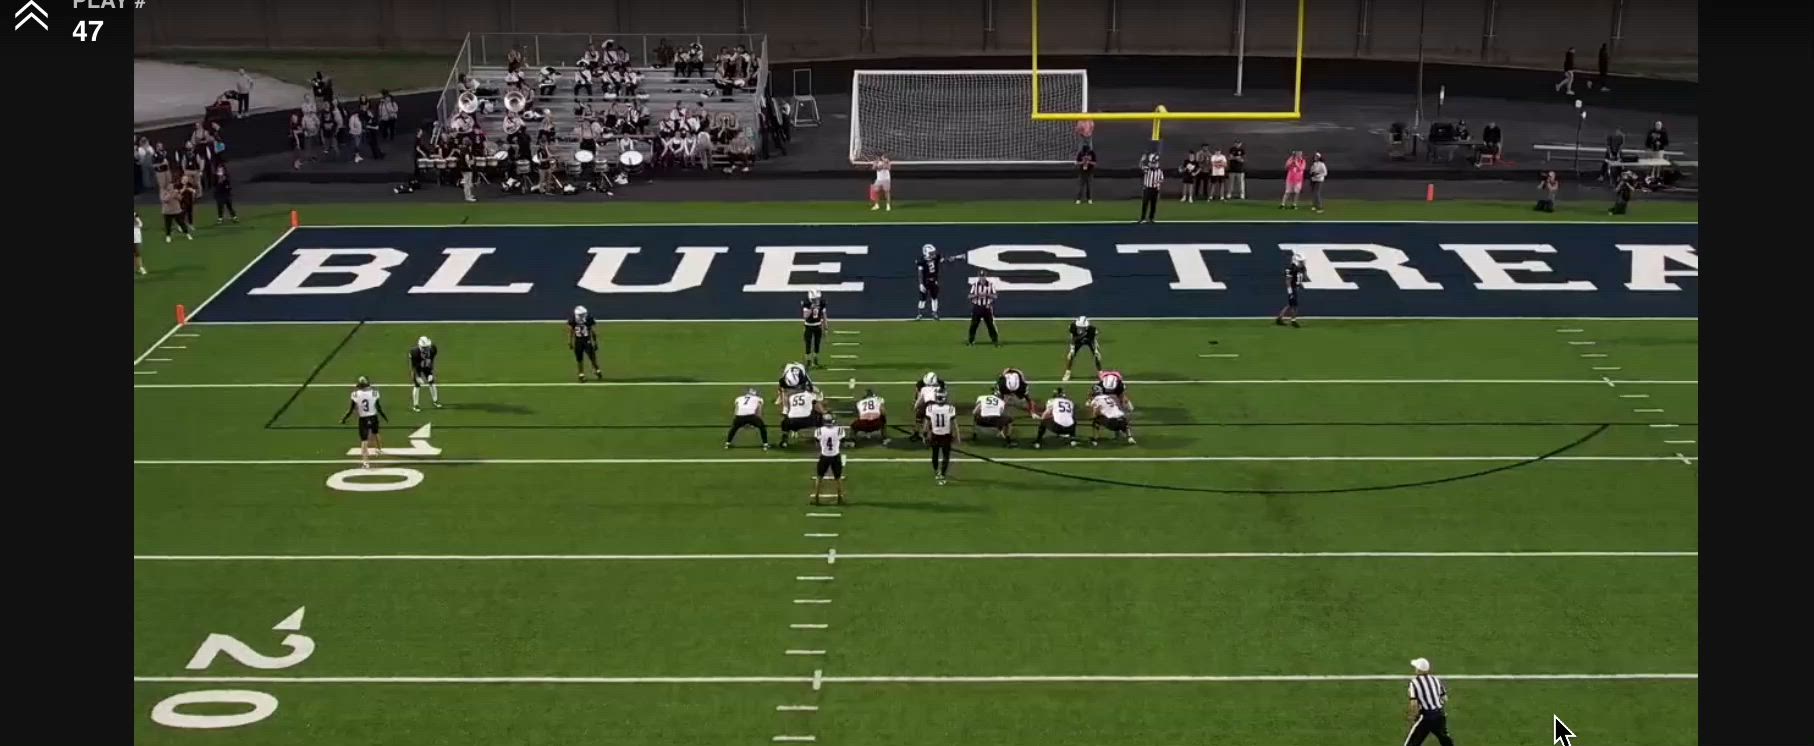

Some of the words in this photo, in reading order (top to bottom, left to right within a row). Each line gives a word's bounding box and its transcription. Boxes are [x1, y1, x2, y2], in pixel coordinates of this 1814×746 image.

[247, 245, 869, 292] BLUE
[362, 399, 370, 412] 3
[743, 396, 751, 406] 7
[792, 396, 806, 407] 55
[861, 400, 875, 411] 78
[1058, 401, 1073, 413] 53
[935, 413, 946, 428] 11
[826, 436, 834, 451] 4
[326, 439, 443, 492] 10
[150, 632, 316, 729] 20
